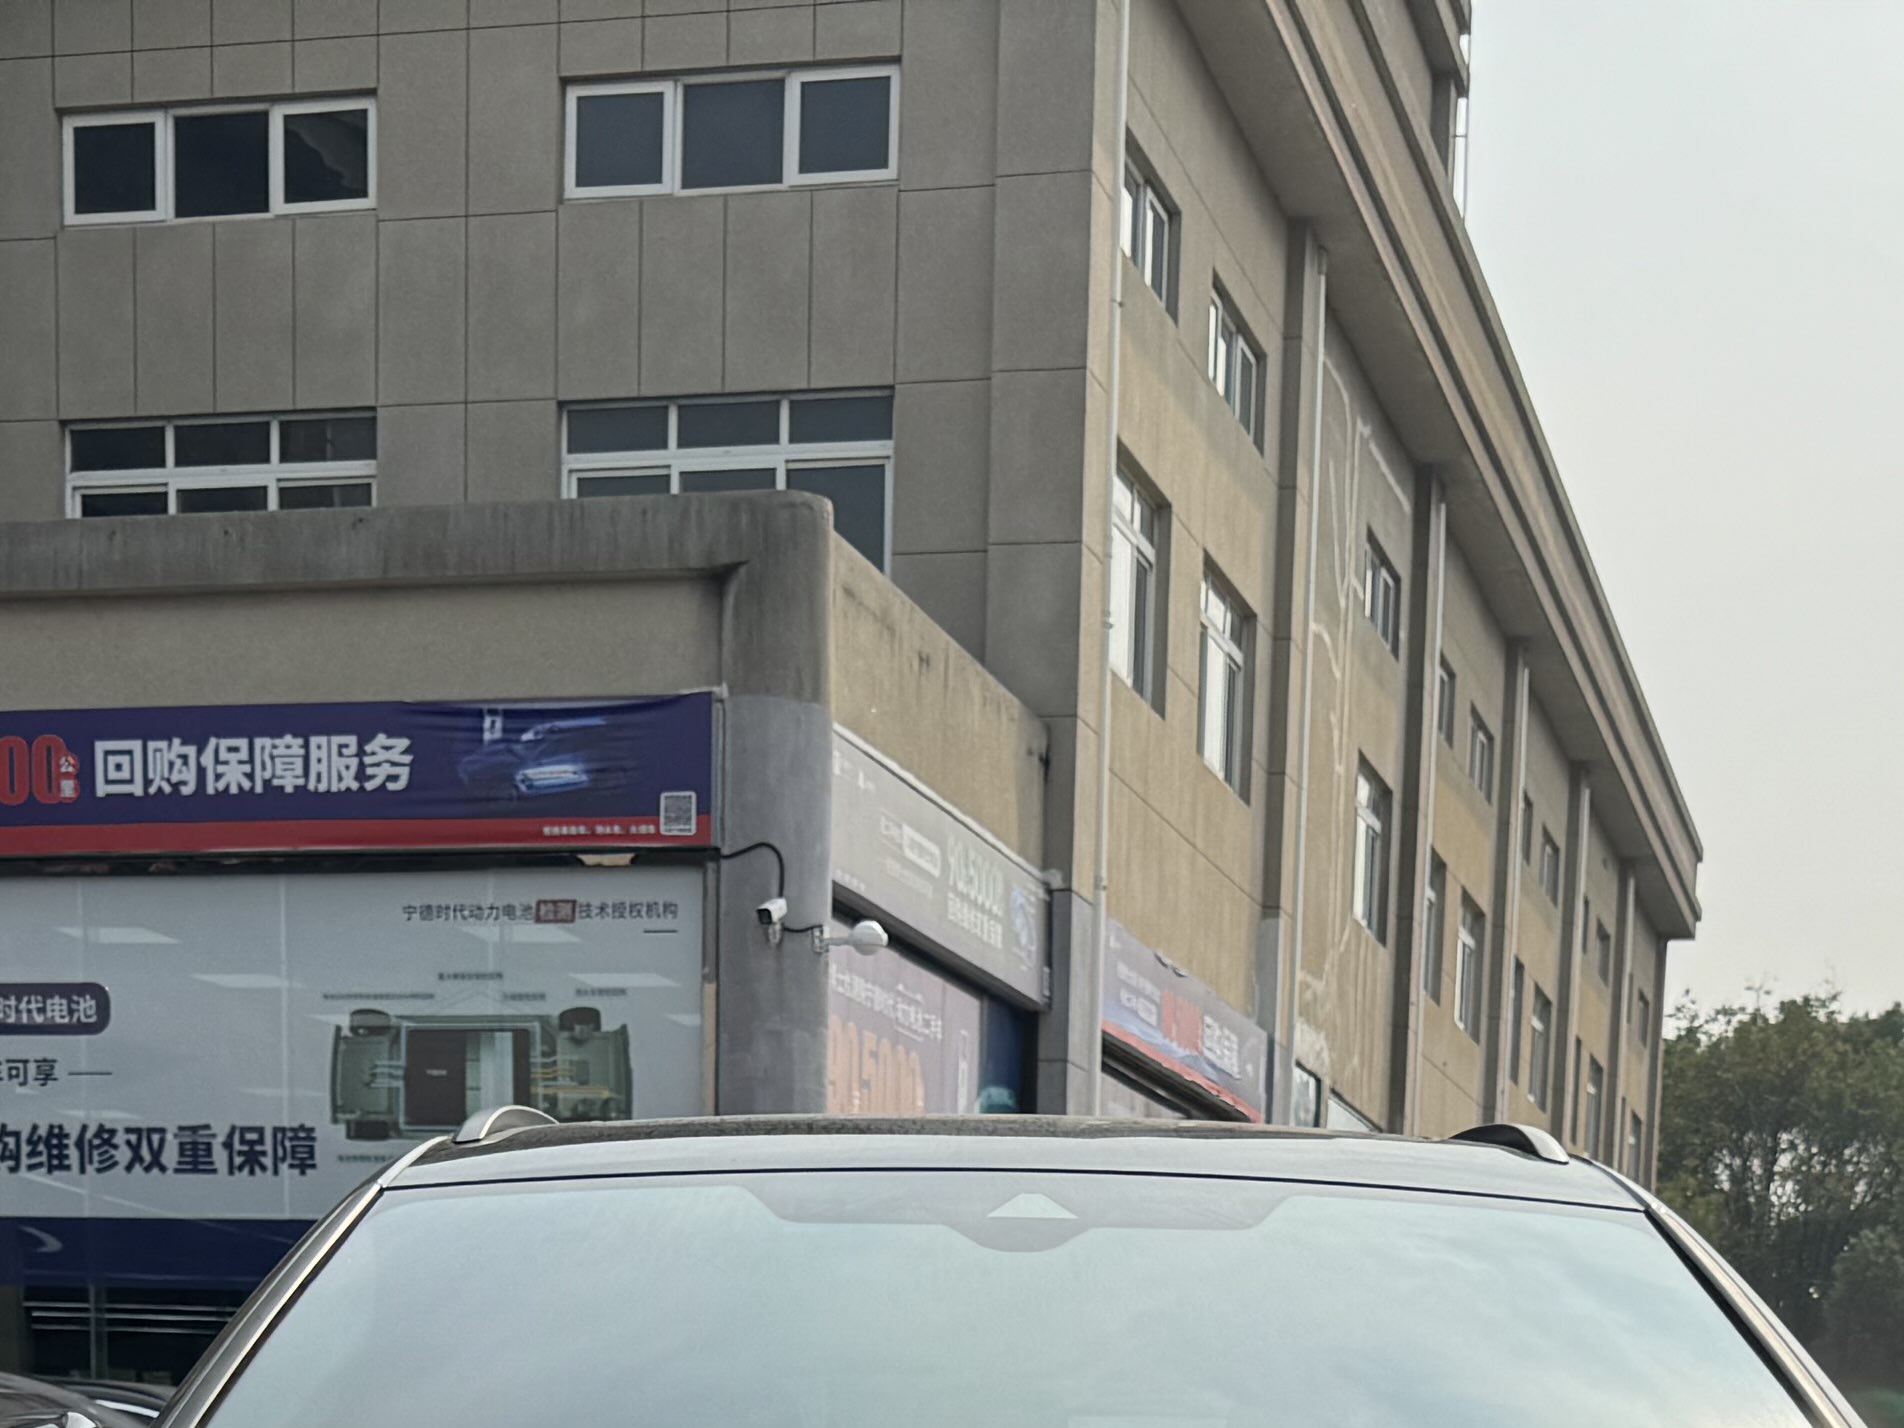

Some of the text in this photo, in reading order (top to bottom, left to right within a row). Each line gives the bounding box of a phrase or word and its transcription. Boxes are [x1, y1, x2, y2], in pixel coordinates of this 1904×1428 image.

[94, 733, 415, 798] 回购保障服务
